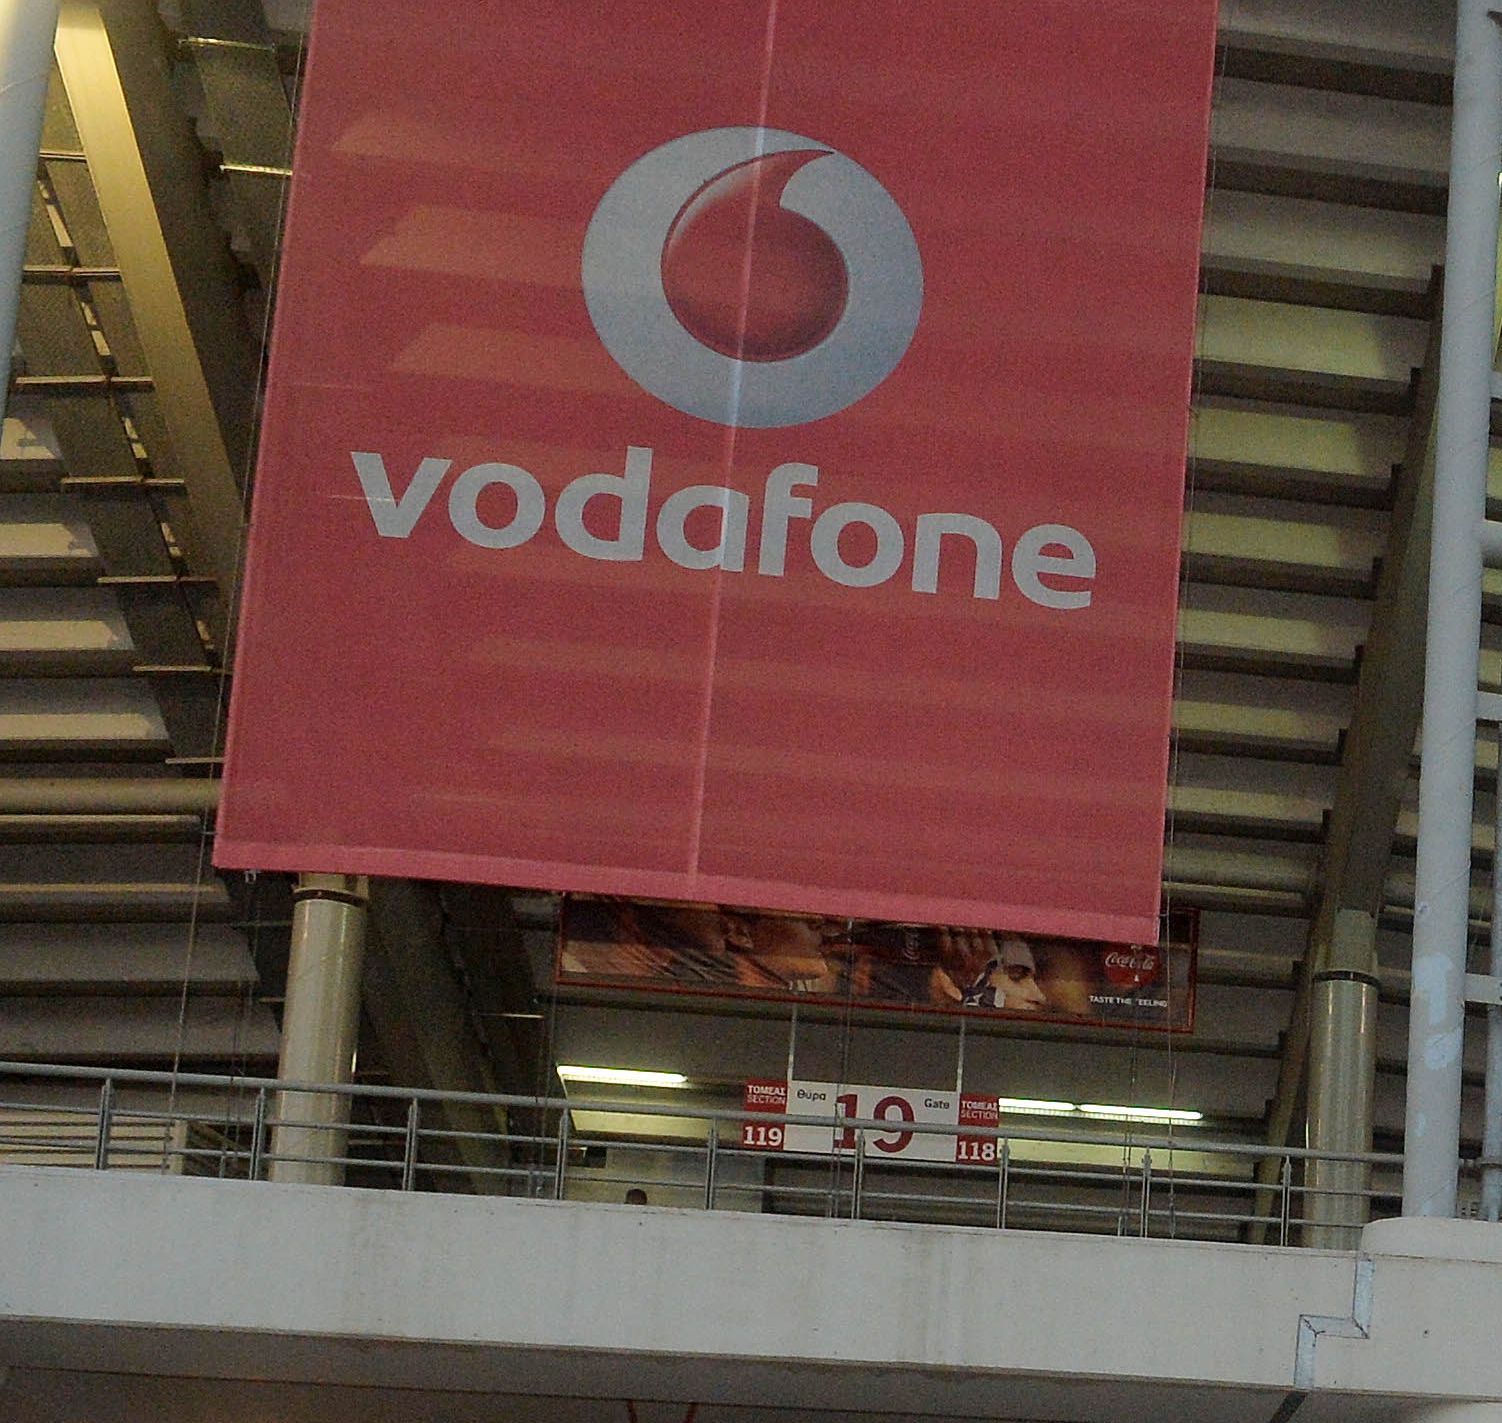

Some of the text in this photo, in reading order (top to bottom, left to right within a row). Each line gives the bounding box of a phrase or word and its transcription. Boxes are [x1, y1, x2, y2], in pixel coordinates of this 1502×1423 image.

[350, 445, 1097, 610] vodafone
[1089, 995, 1114, 1004] TASTE
[1136, 998, 1168, 1008] EELING
[747, 1094, 786, 1105] SECTION
[924, 1098, 950, 1110] Gate
[960, 1108, 999, 1120] SECTION
[834, 1093, 916, 1153] 19
[743, 1125, 783, 1147] 119
[958, 1139, 995, 1161] 118
